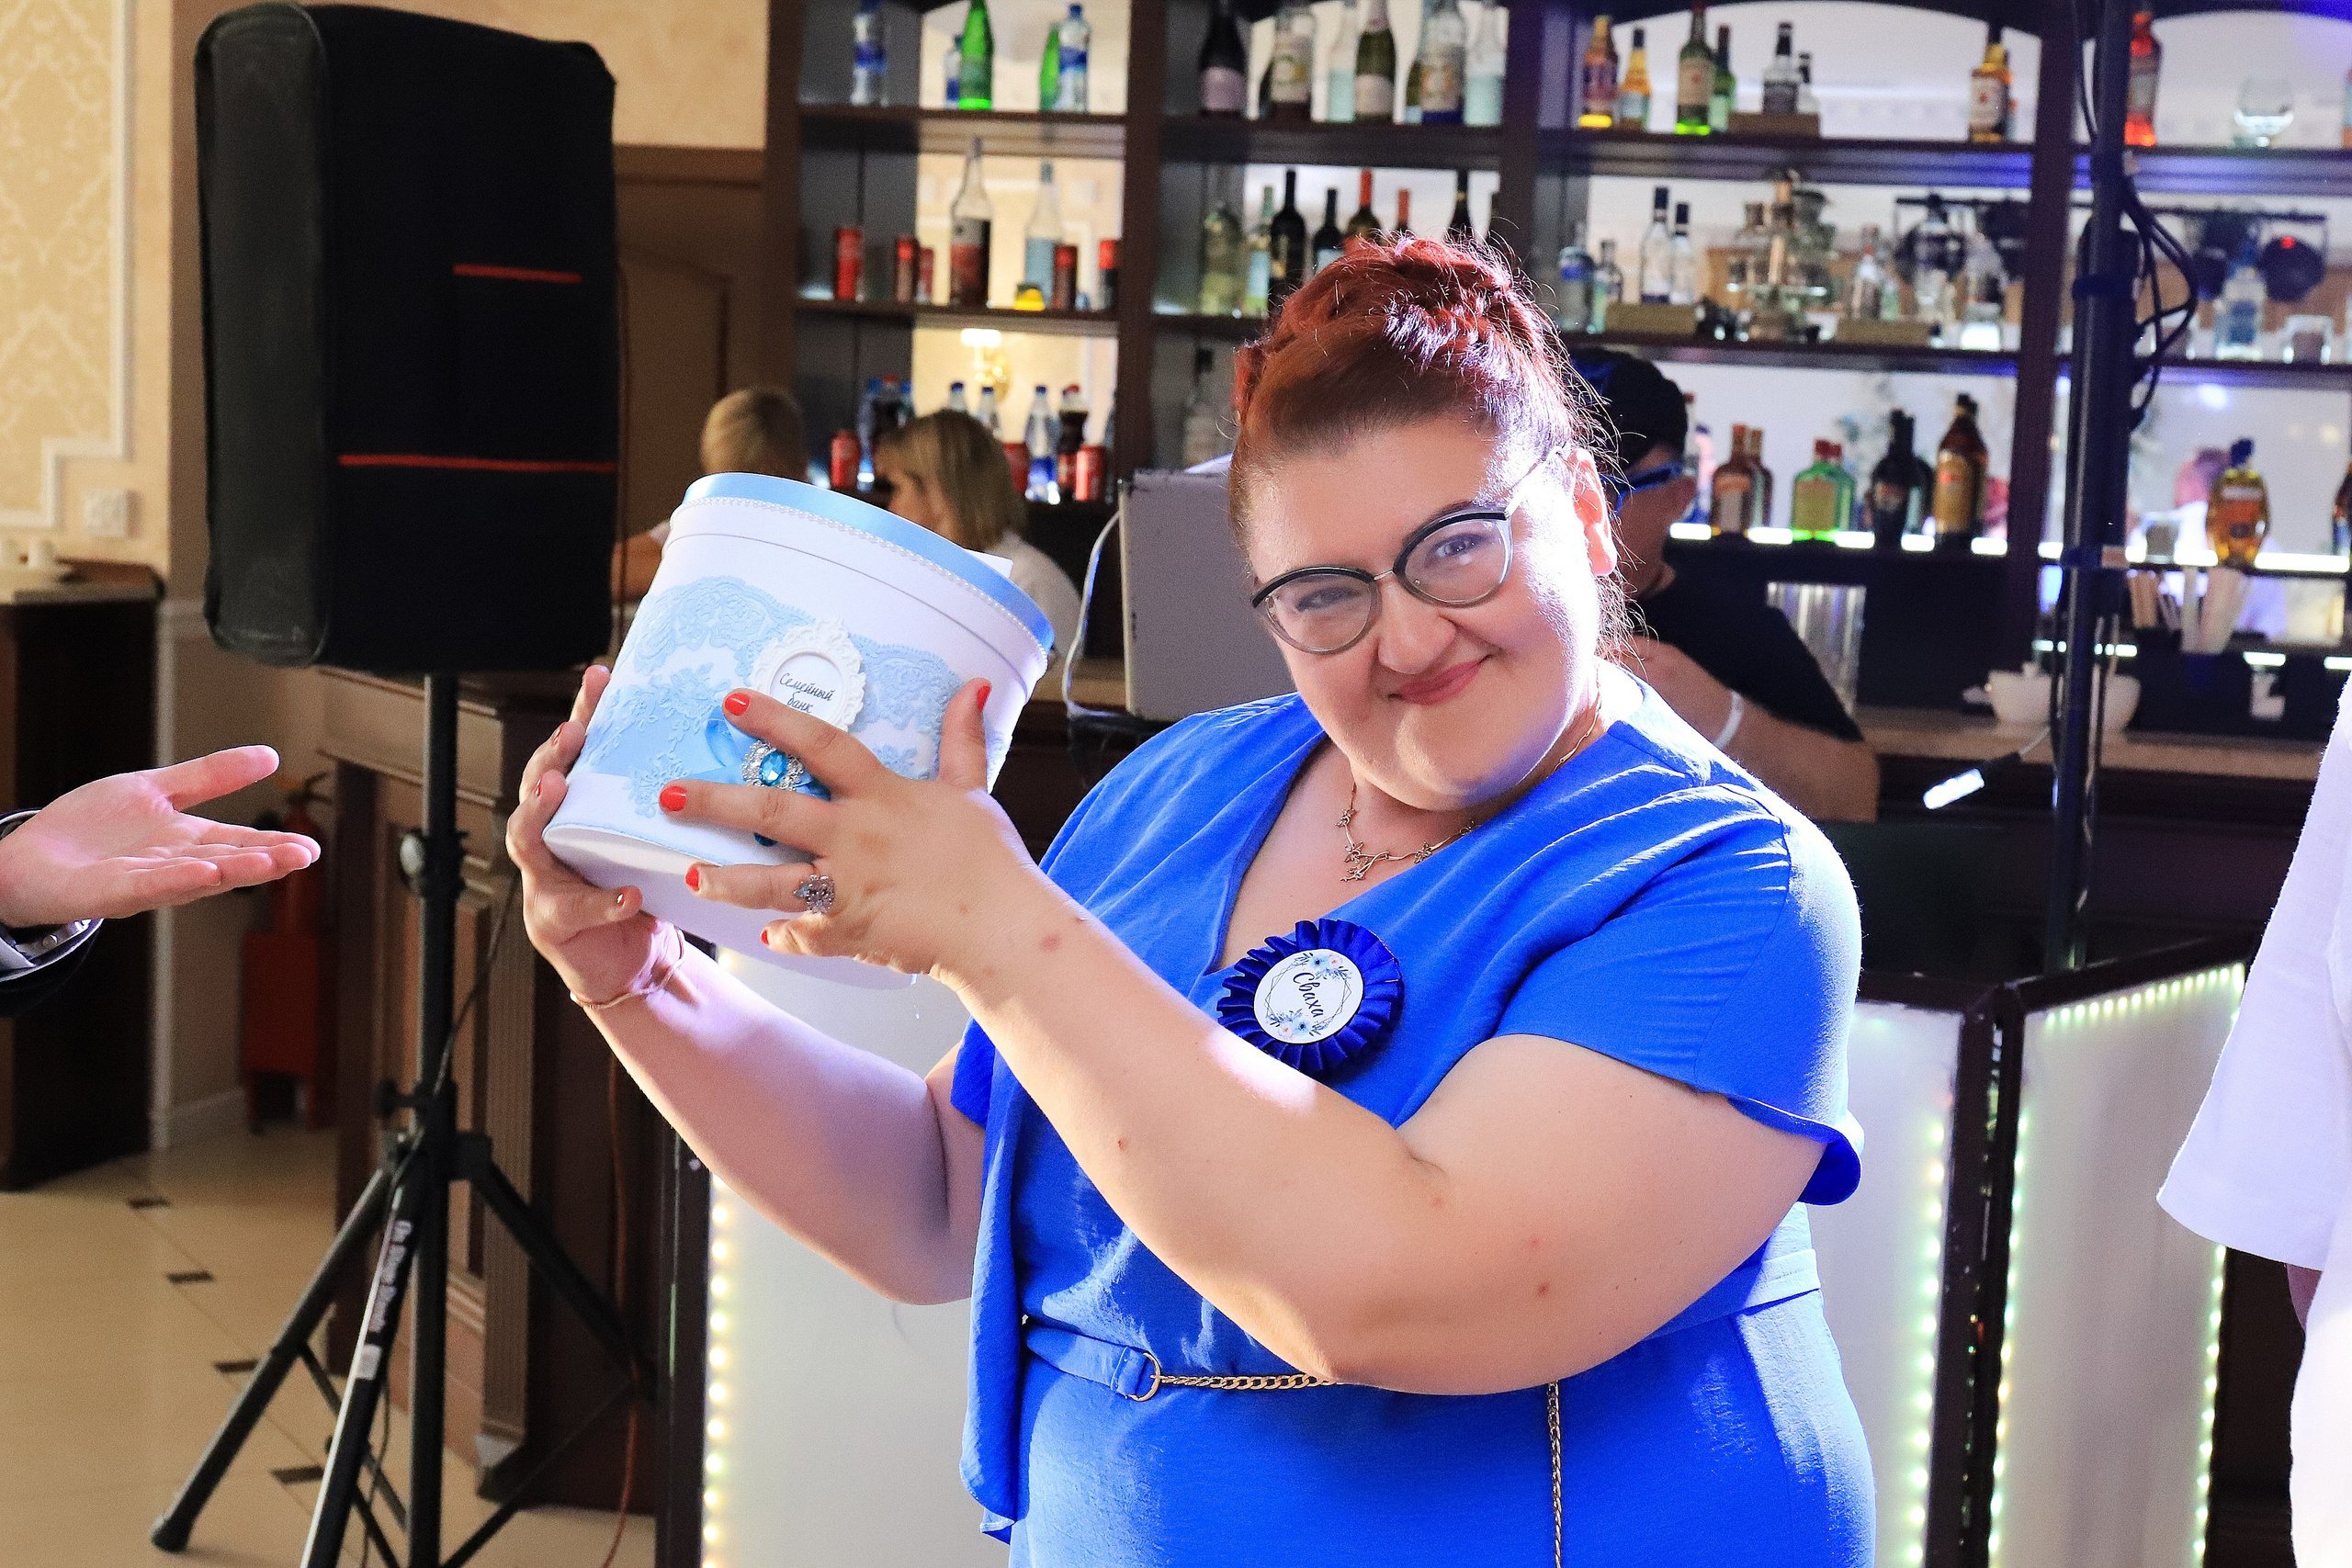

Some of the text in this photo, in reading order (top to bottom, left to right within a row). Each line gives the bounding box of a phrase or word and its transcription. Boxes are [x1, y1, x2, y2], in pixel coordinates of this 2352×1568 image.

[779, 672, 836, 702] Семейный
[786, 691, 814, 714] банк
[1293, 972, 1324, 1018] Сваха
